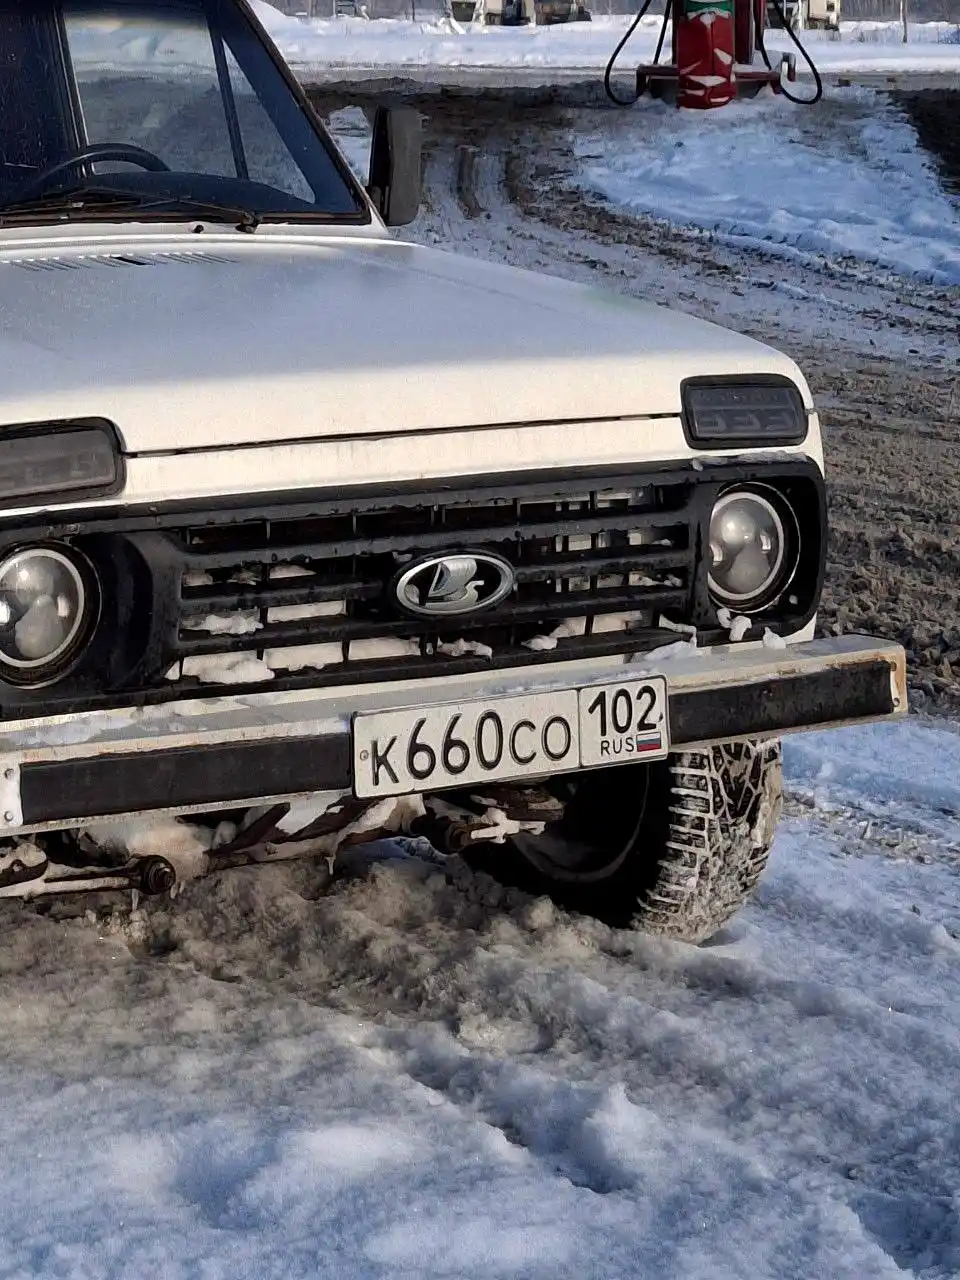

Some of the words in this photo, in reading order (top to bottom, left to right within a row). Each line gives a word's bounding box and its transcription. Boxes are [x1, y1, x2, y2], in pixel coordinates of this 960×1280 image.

[370, 709, 572, 787] К660СО
[588, 685, 657, 737] 102
[600, 736, 635, 757] RUS
